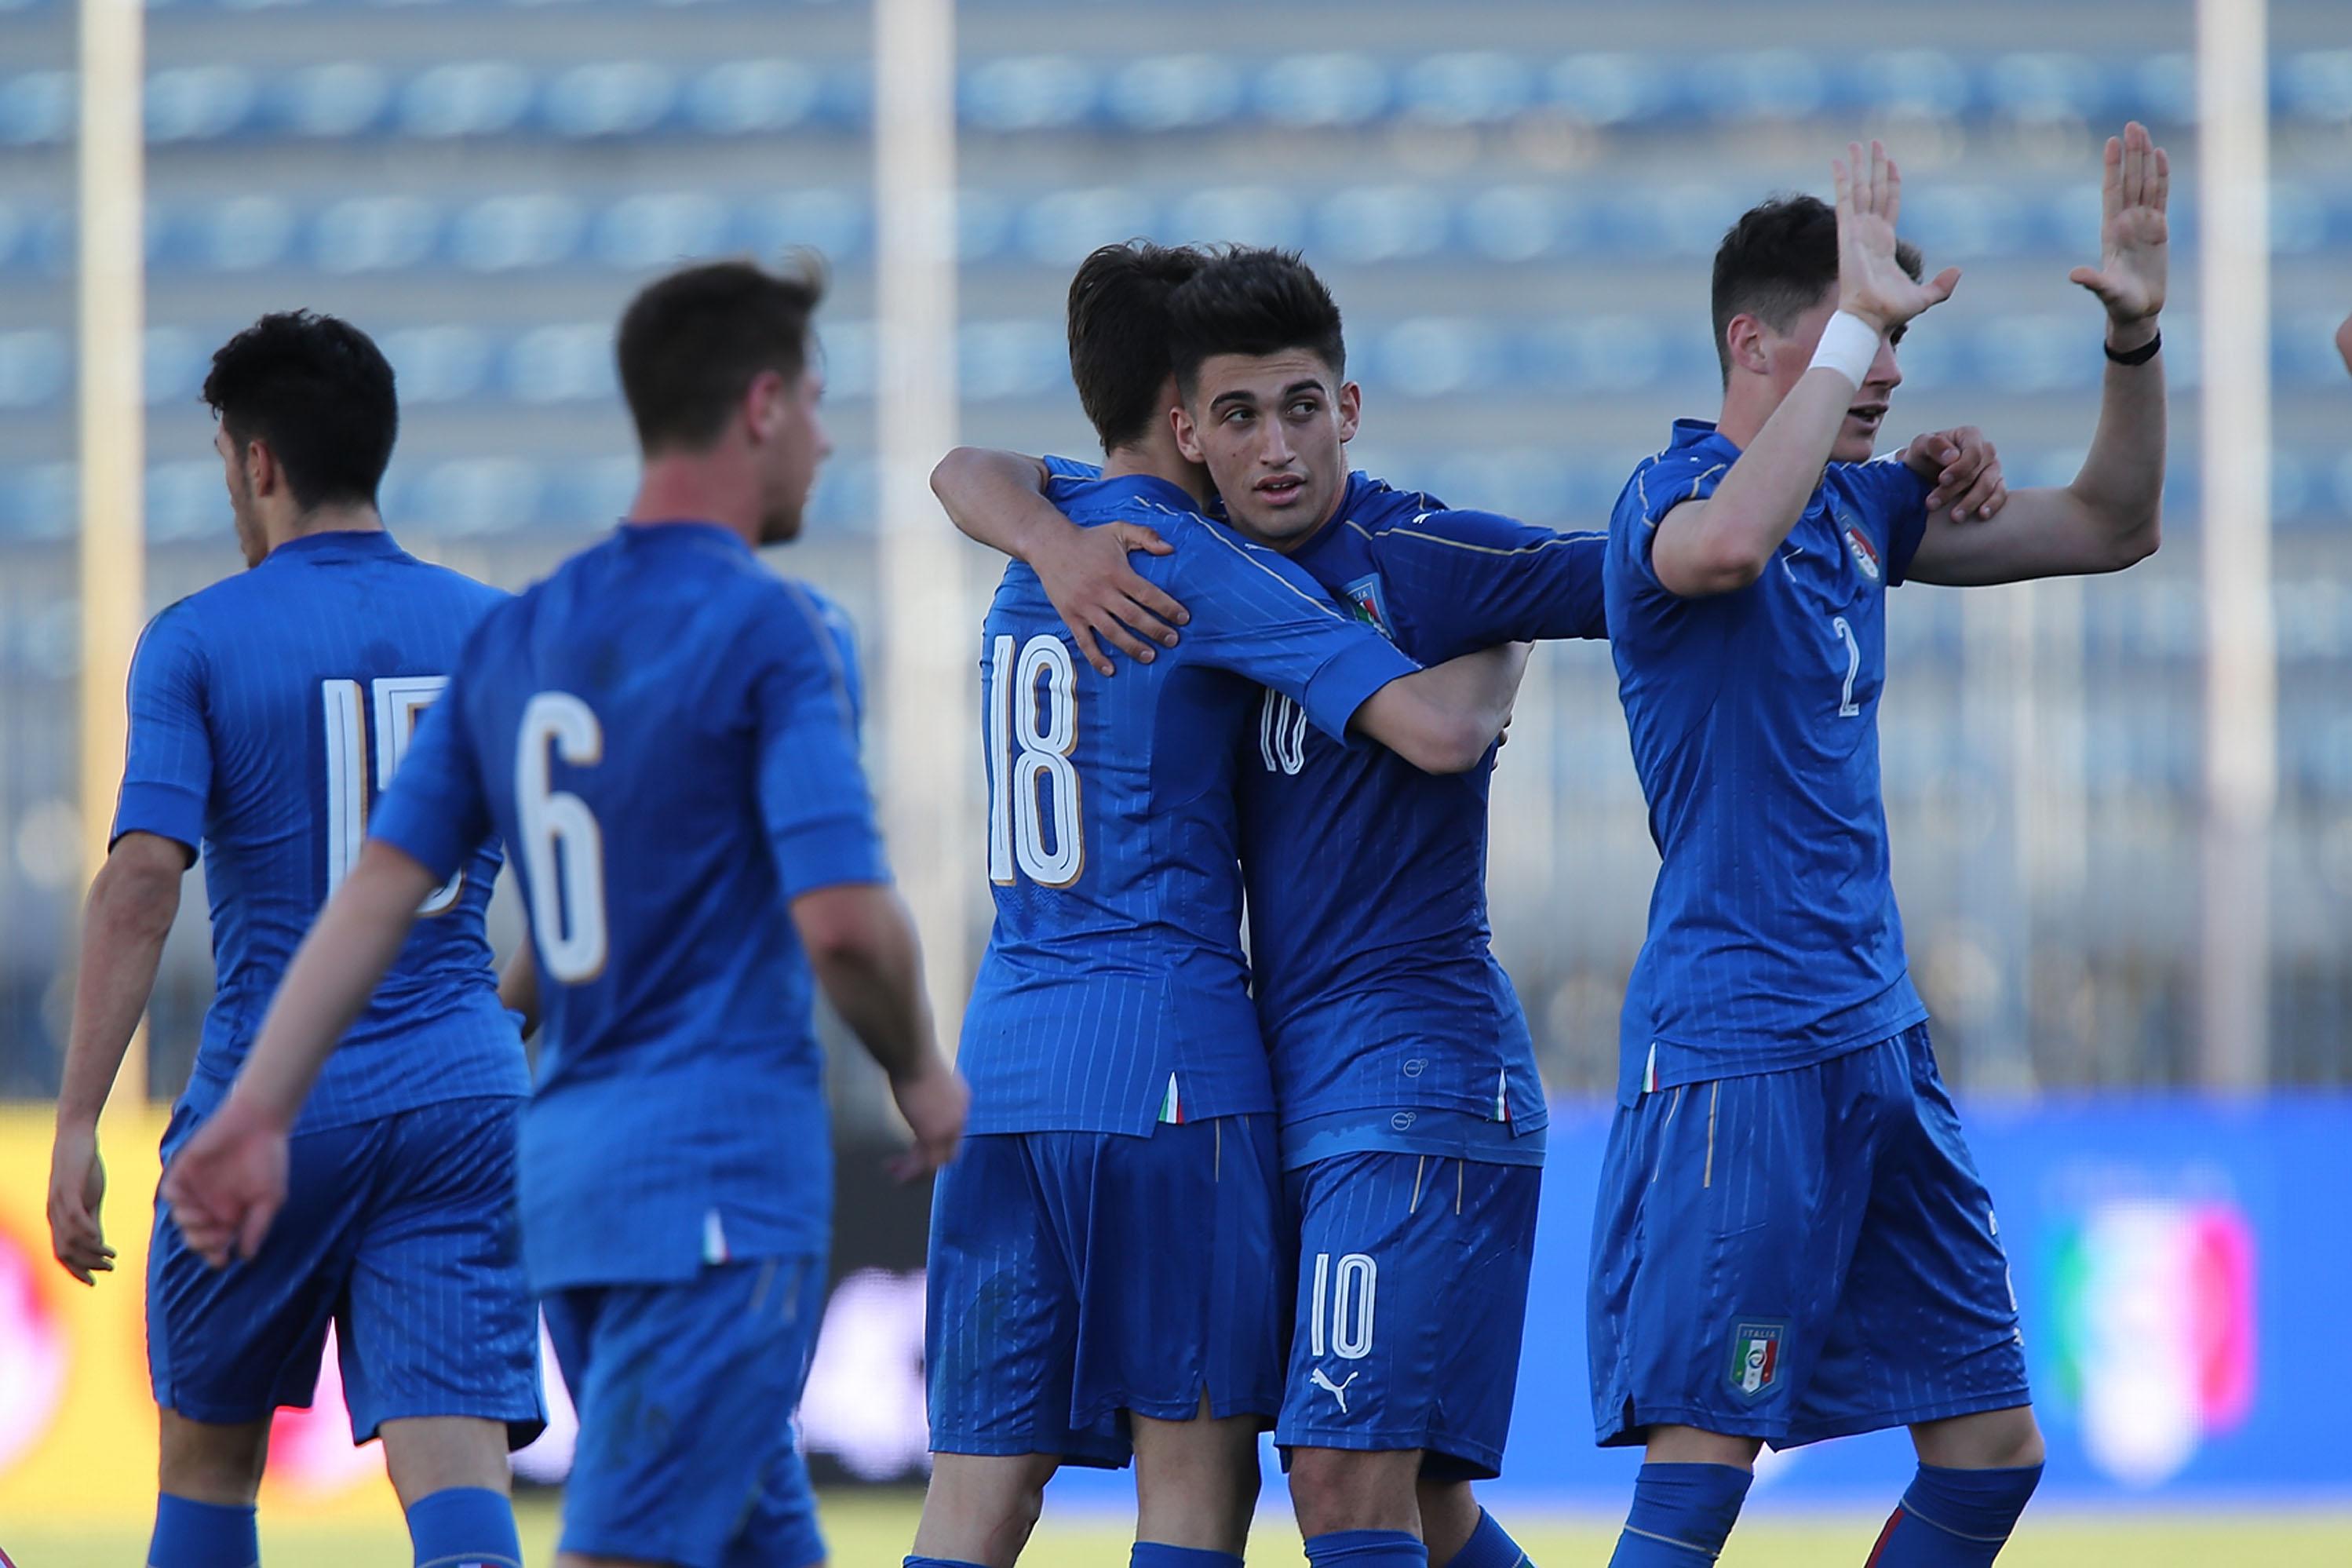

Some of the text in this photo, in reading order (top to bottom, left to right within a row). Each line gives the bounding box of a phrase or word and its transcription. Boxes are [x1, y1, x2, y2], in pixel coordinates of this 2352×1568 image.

[1832, 616, 1860, 717] 2
[990, 634, 1085, 889] 18
[1260, 687, 1307, 775] 10
[516, 691, 607, 982] 6
[1311, 1253, 1377, 1360] 10
[1743, 1329, 1776, 1338] ITALIA
